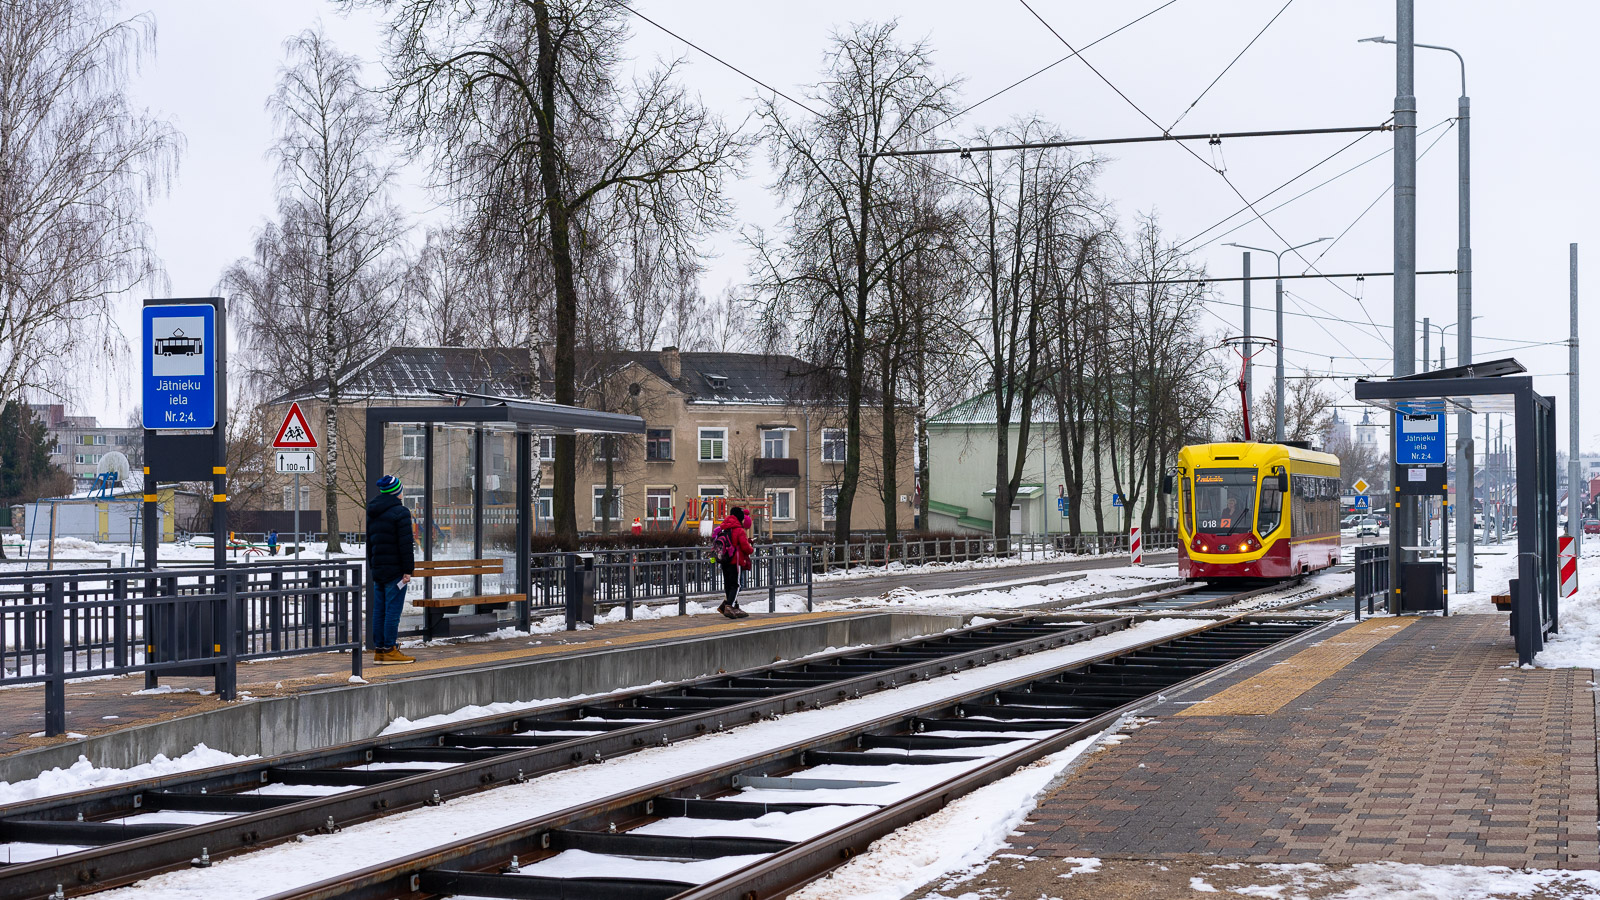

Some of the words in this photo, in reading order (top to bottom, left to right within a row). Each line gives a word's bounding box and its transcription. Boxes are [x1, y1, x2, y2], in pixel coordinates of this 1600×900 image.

[156, 379, 201, 391] Jātnieku
[169, 394, 188, 405] iela
[165, 410, 178, 422] Nr.
[286, 463, 298, 471] 100
[1202, 520, 1217, 528] 018
